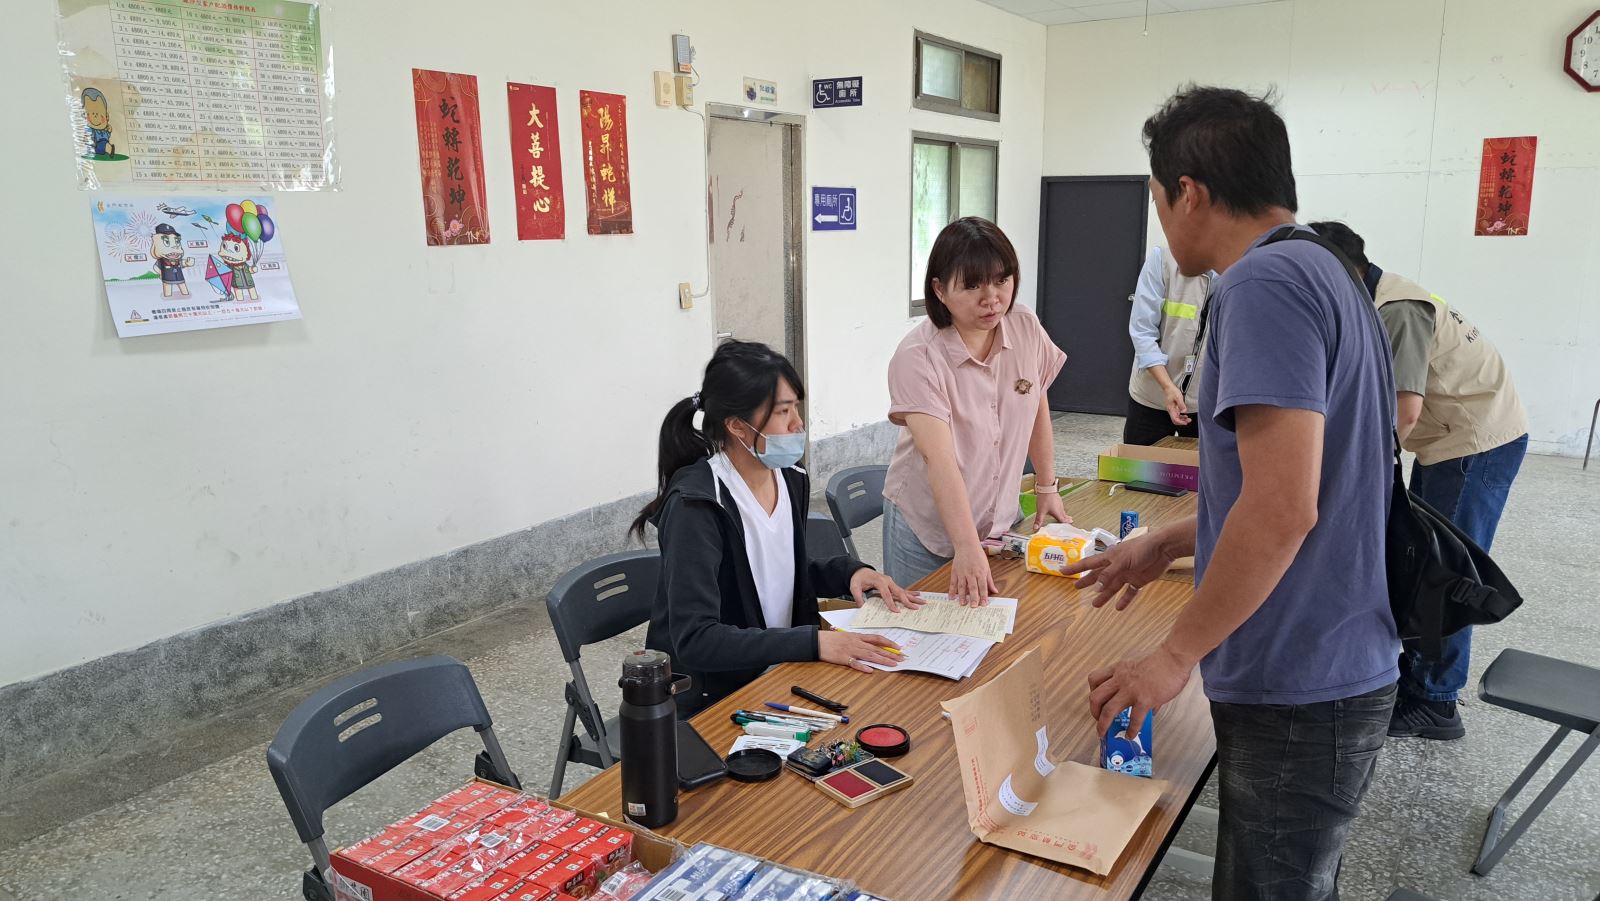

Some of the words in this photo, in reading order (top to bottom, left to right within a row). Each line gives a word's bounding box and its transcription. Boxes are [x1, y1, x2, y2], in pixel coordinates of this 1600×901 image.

[1583, 36, 1593, 45] 10
[1580, 49, 1586, 58] 9
[1583, 61, 1589, 69] 8
[1593, 69, 1599, 78] 7
[527, 103, 551, 213] 大菩提心
[1159, 471, 1194, 481] PREMIUM
